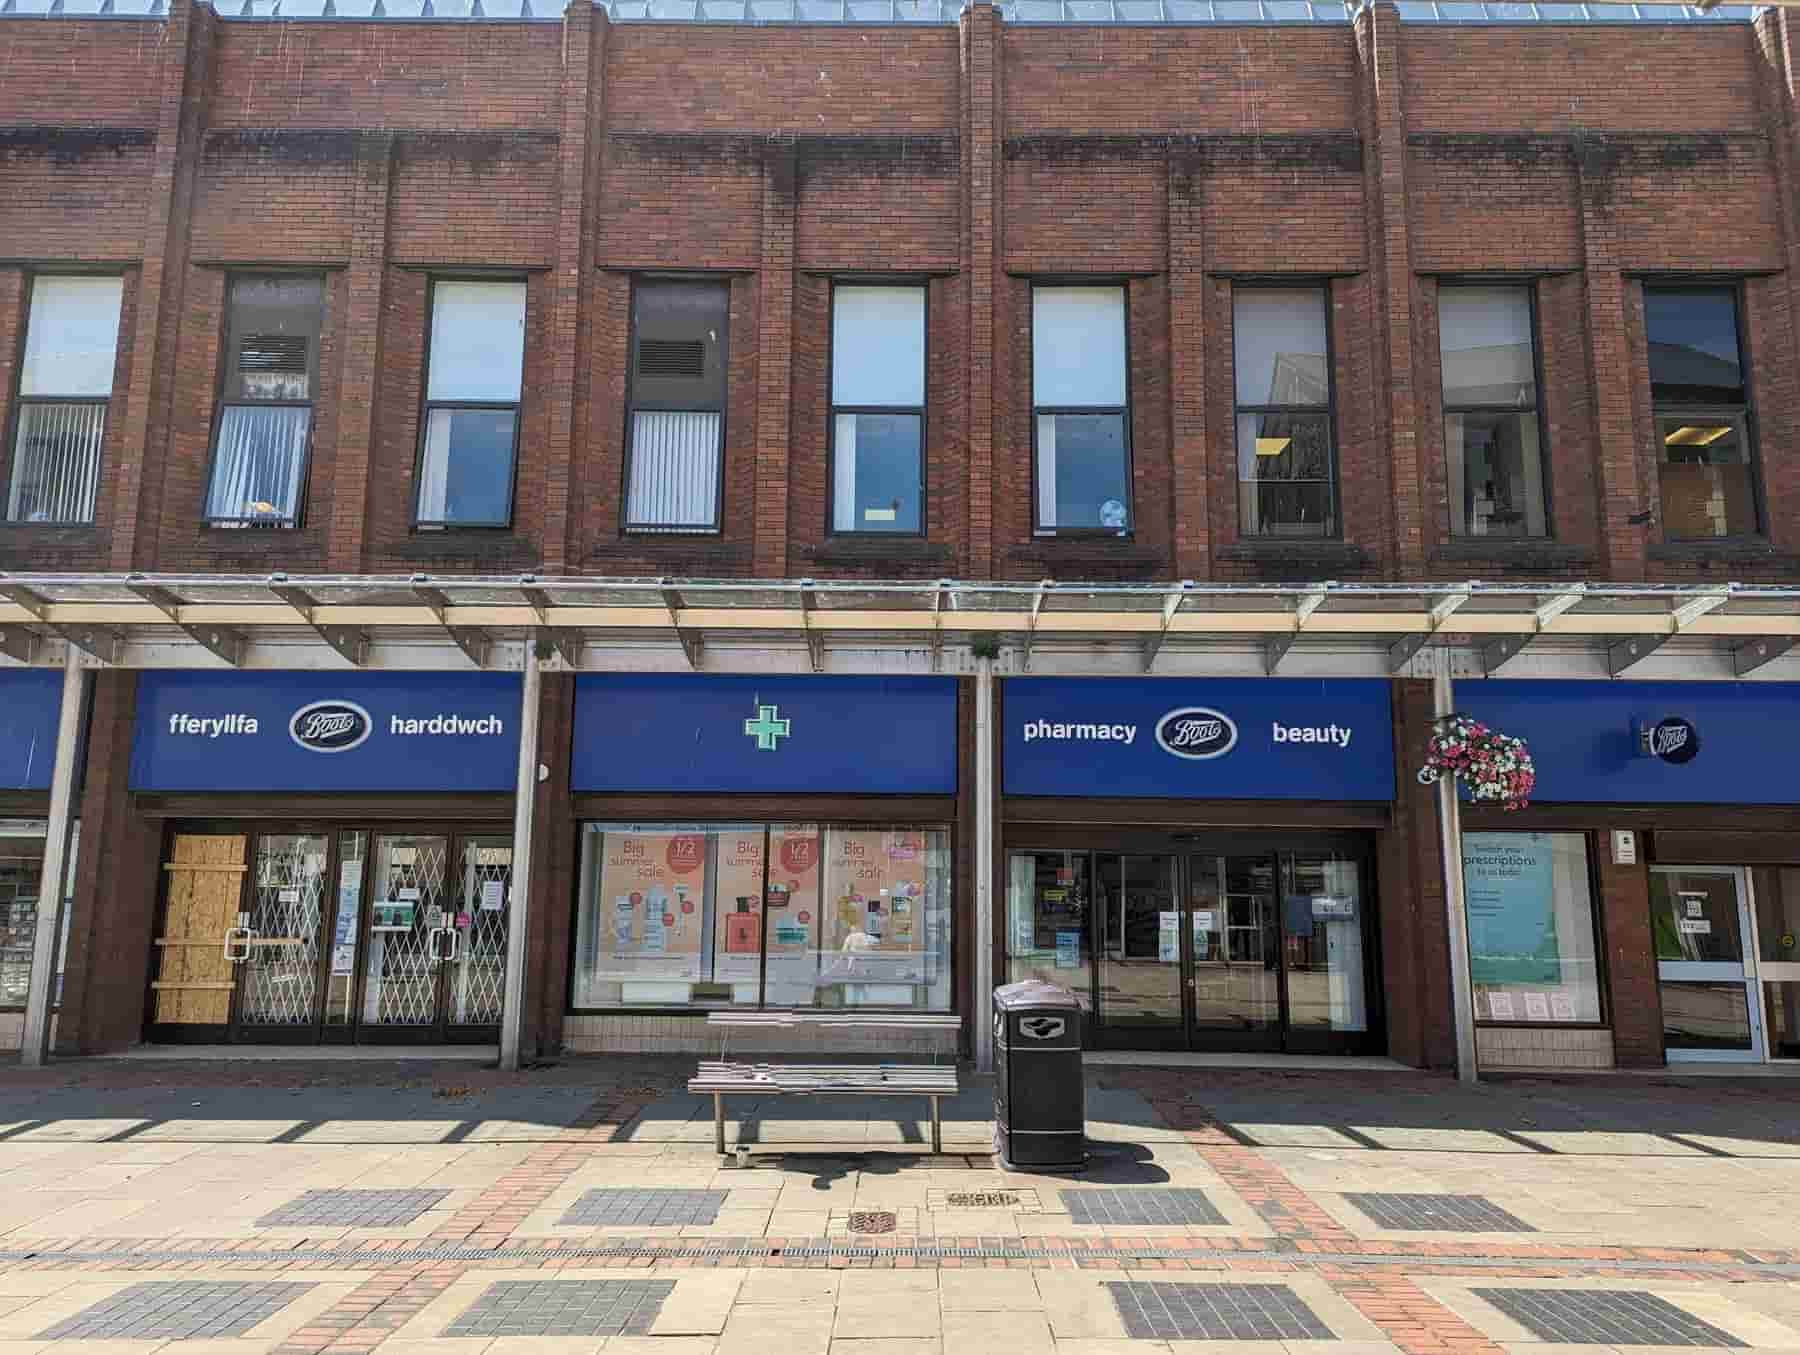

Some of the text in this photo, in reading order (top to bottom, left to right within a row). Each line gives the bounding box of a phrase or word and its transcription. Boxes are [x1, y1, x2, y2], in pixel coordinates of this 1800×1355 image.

[169, 713, 259, 738] fferyllfa
[301, 711, 355, 740] Boots
[390, 714, 503, 735] harddwch
[1023, 719, 1137, 745] pharmacy
[1168, 718, 1222, 746] Boots
[1272, 722, 1352, 748] beauty
[1463, 854, 1537, 868] prescriptions
